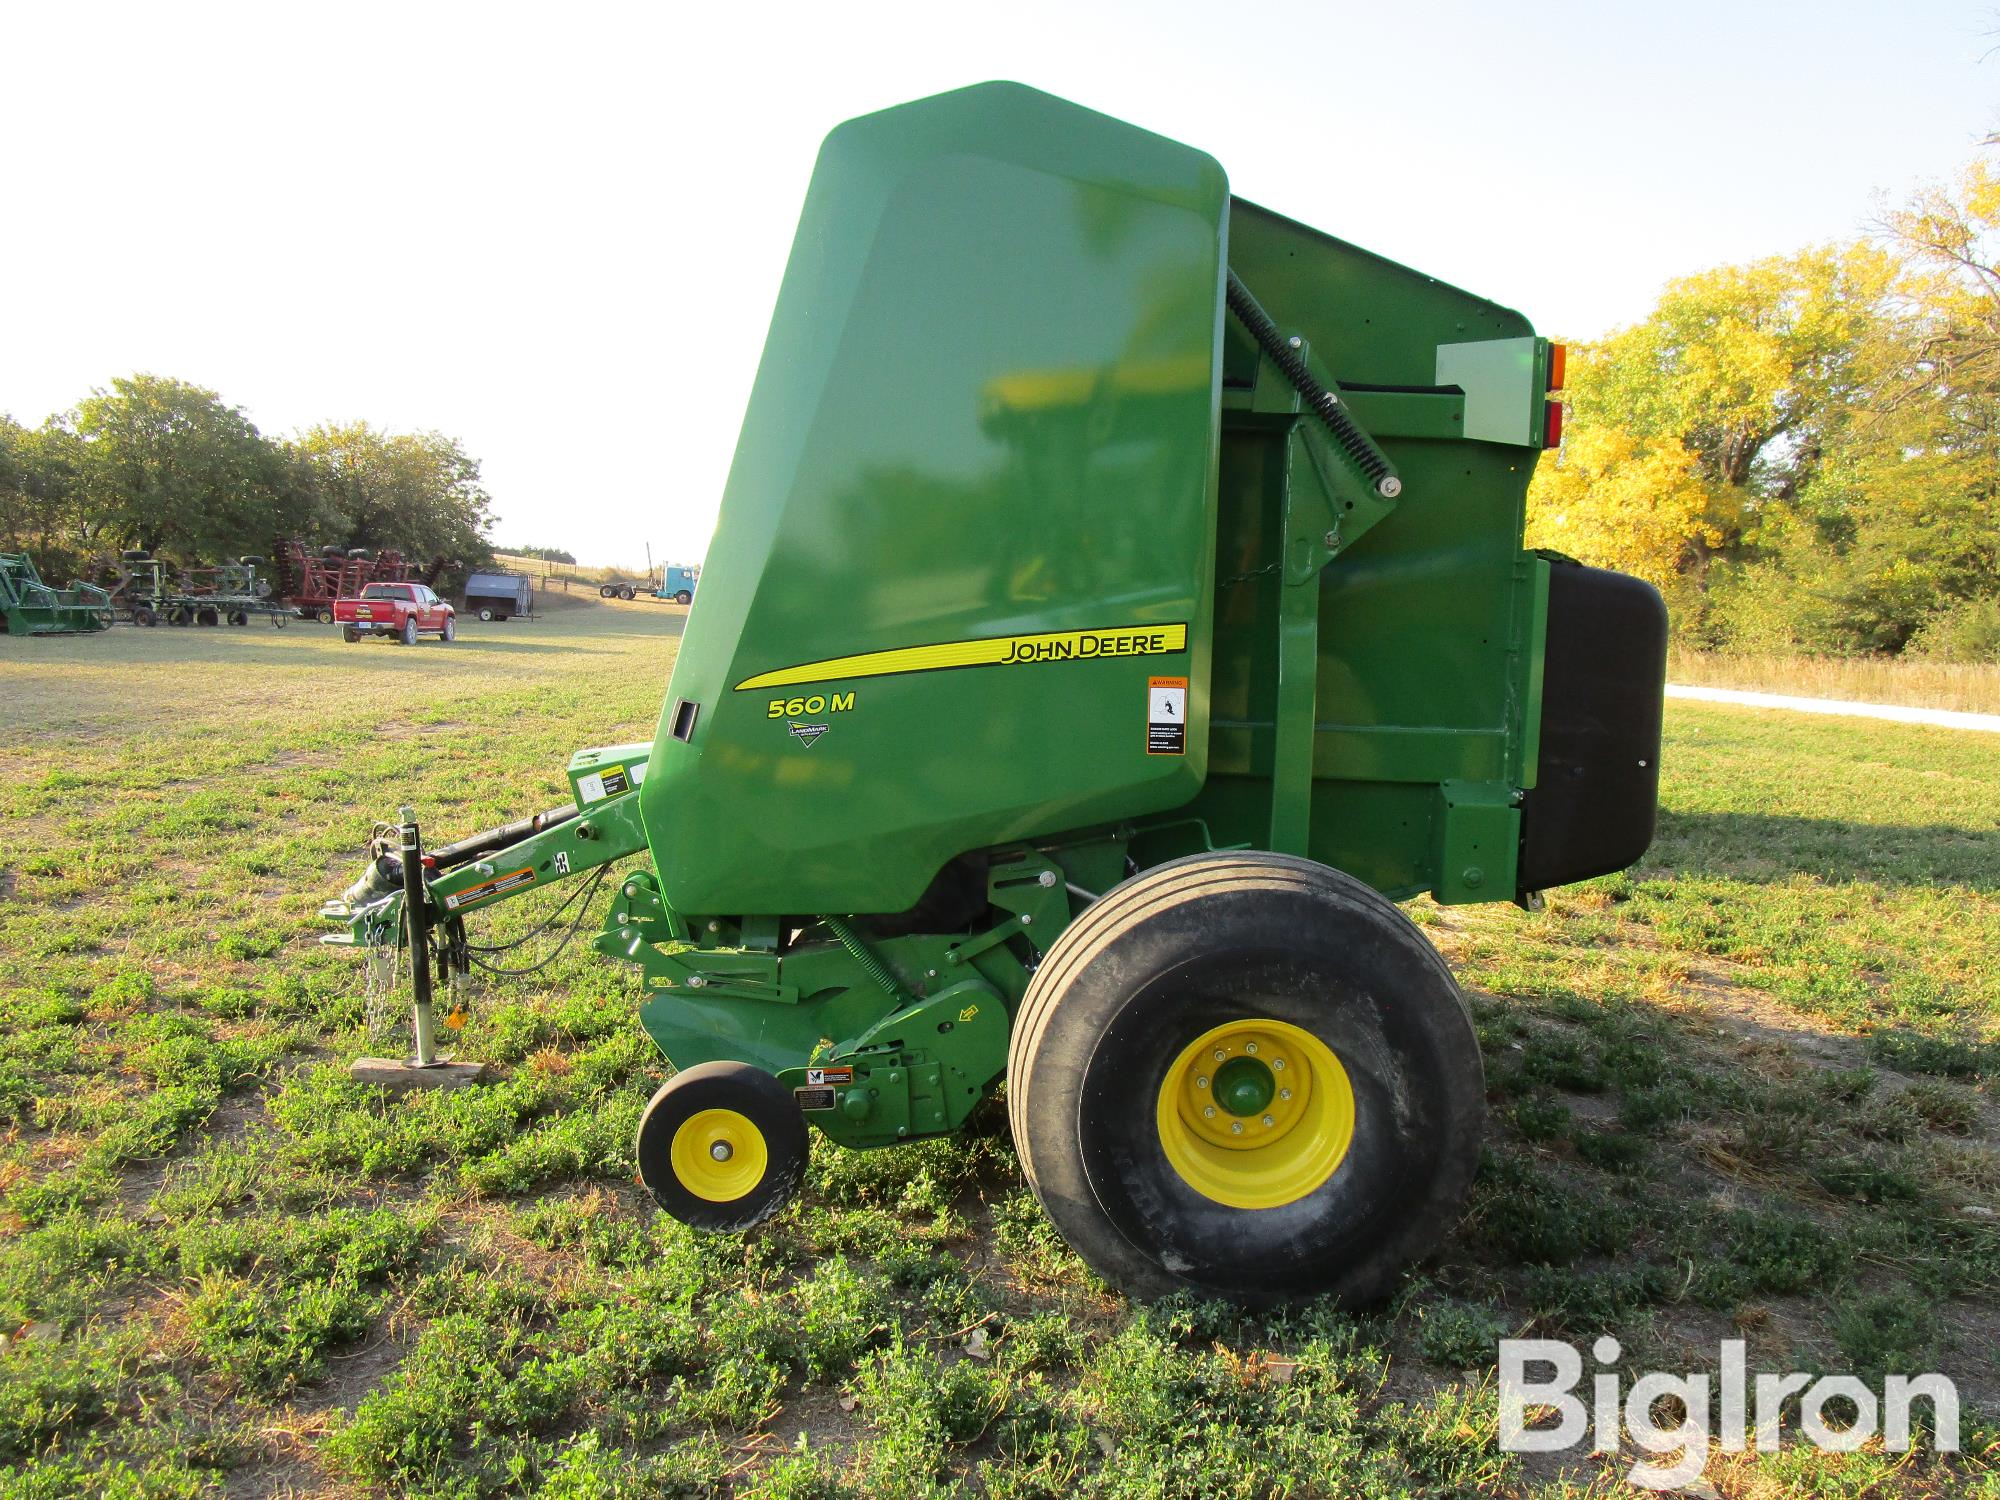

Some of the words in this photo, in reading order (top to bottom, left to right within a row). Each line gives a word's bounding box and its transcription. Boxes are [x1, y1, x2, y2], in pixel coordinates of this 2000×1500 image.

[1001, 640, 1072, 661] JOHN
[1079, 634, 1165, 656] DEERE
[767, 695, 827, 719] 560
[830, 691, 856, 713] M
